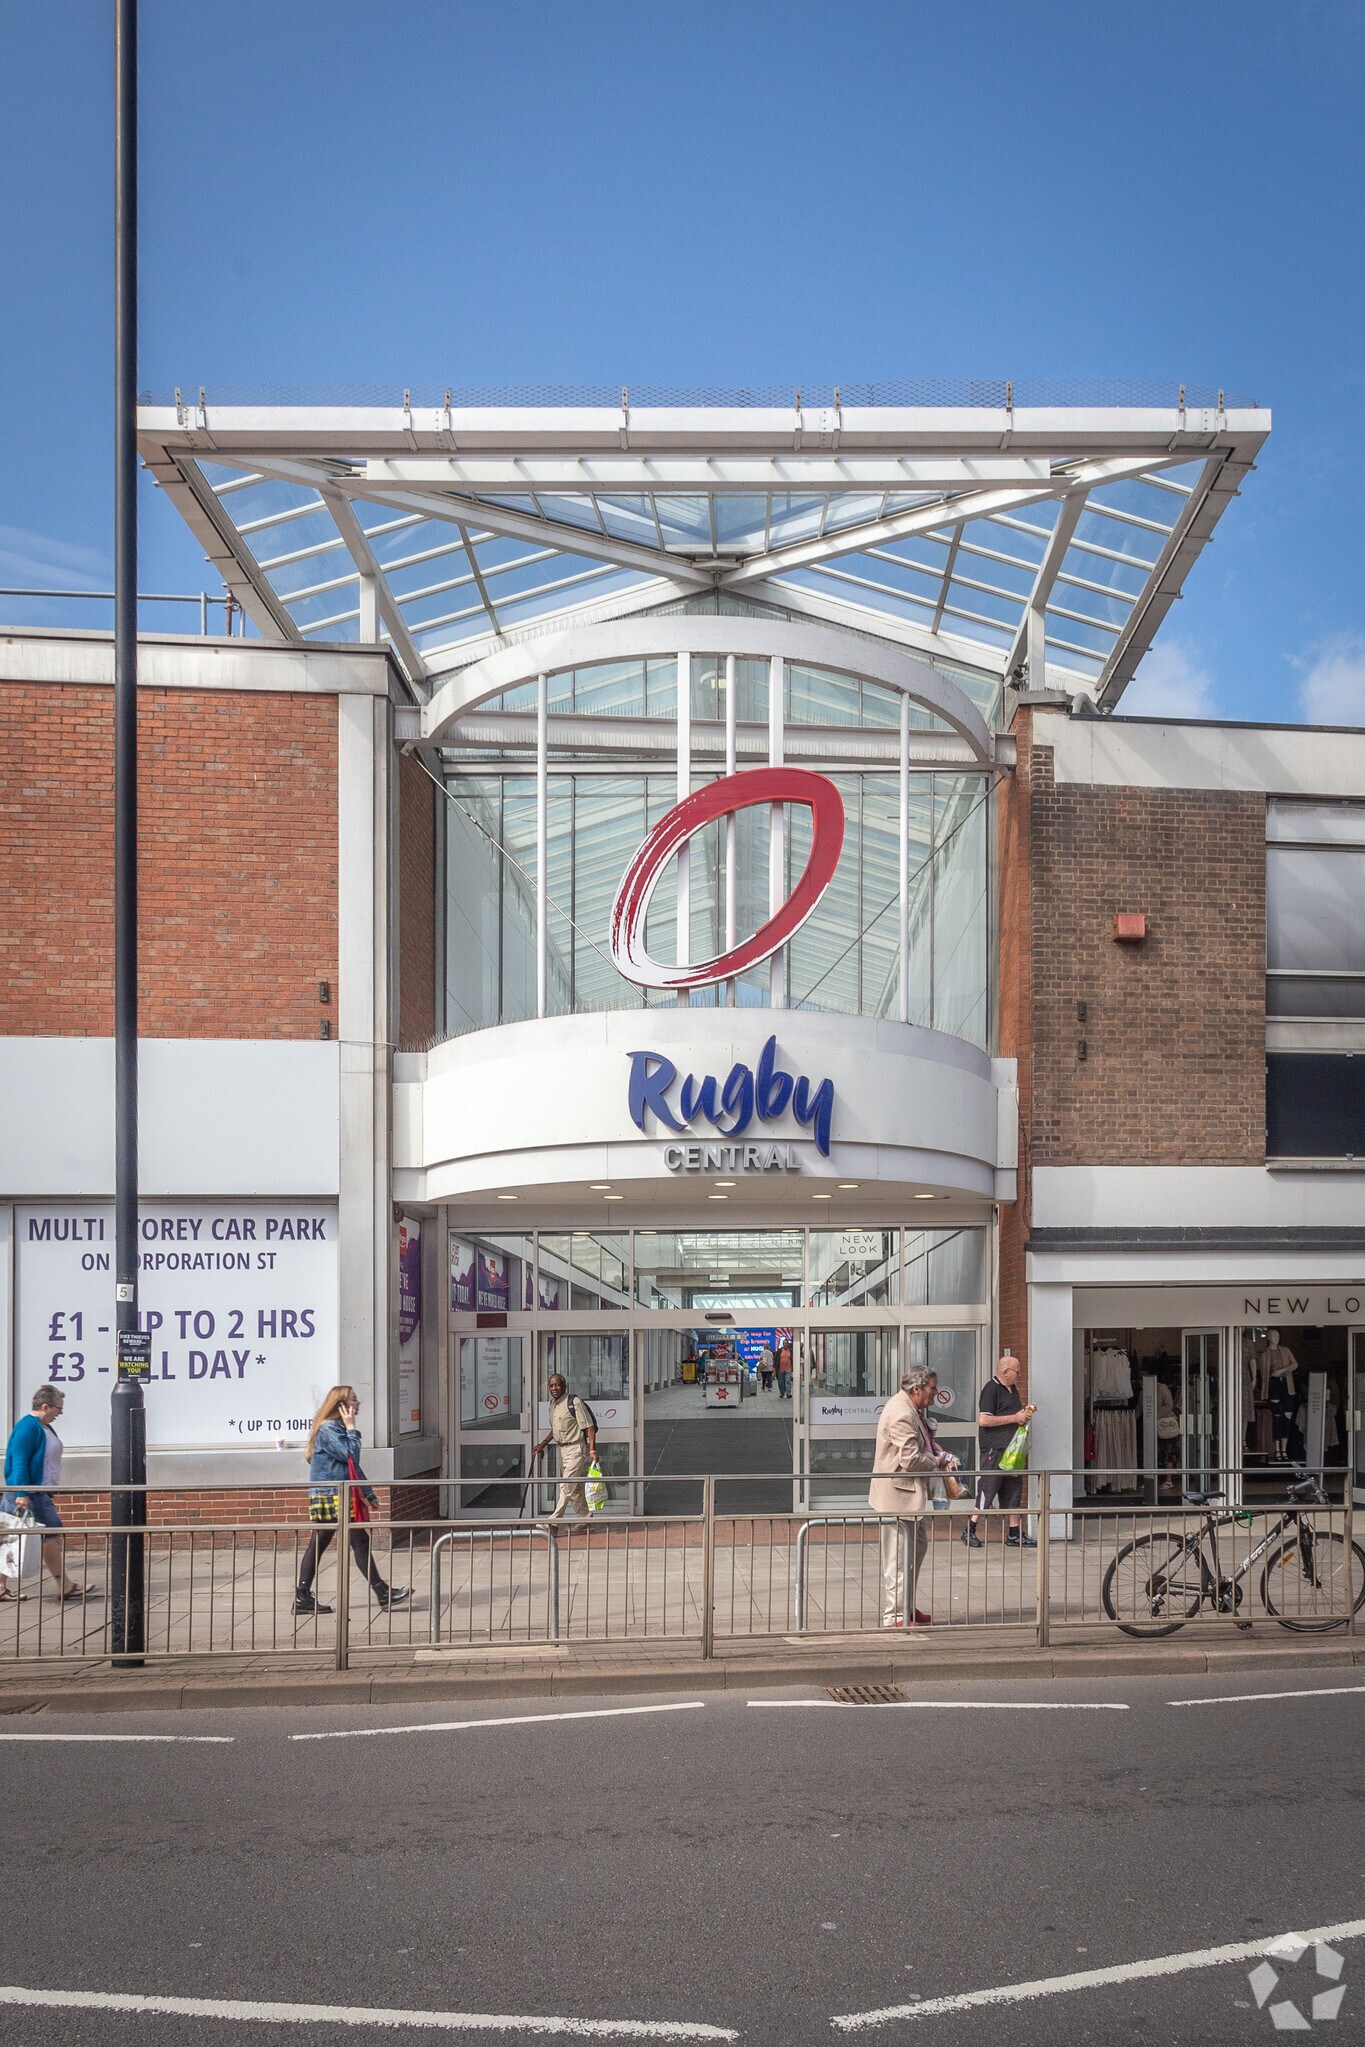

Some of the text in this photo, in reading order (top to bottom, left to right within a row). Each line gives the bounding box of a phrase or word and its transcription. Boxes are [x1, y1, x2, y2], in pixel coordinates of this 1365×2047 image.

[626, 1035, 835, 1157] Rugby
[664, 1144, 803, 1170] CENTRAL
[28, 1218, 327, 1241] MULTI OREY CAR PARK
[842, 1235, 874, 1244] NEW
[839, 1246, 878, 1255] LOOK
[81, 1252, 277, 1271] ON RPORATION ST
[120, 1287, 128, 1298] 5
[1245, 1297, 1360, 1314] NEW LO
[49, 1312, 83, 1341] £1
[174, 1310, 216, 1340] TO
[227, 1309, 245, 1339] 2
[257, 1309, 316, 1339] HRS
[49, 1352, 85, 1381] £3
[822, 1405, 842, 1416] Rugby
[247, 1420, 263, 1431] UP
[266, 1419, 281, 1431] TO
